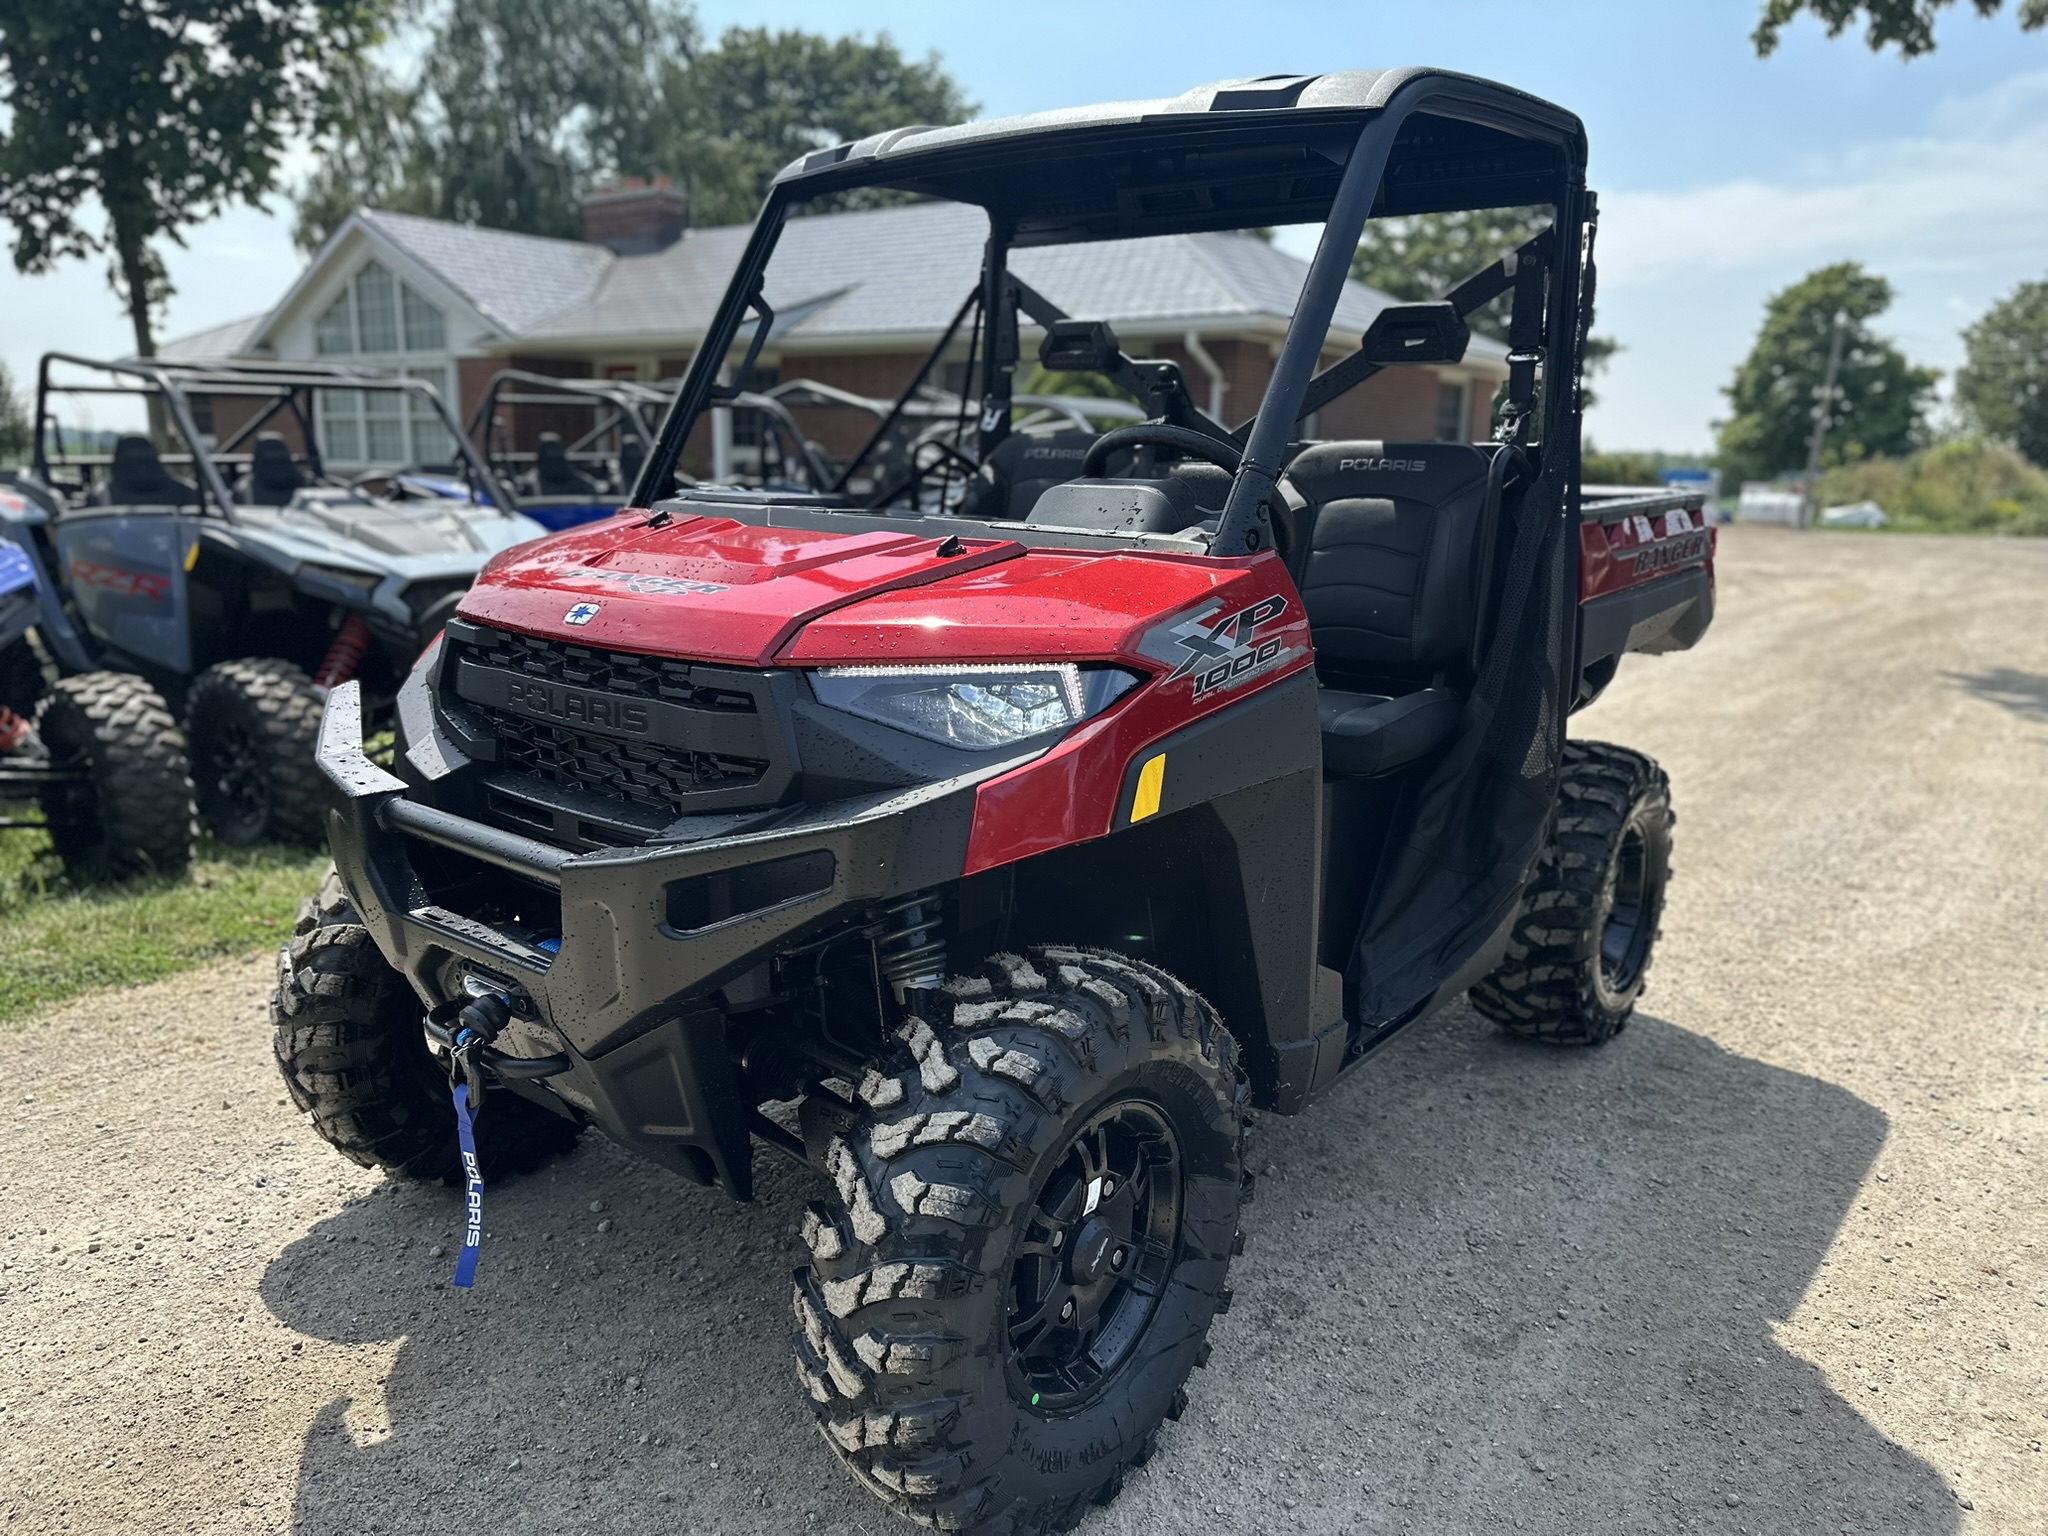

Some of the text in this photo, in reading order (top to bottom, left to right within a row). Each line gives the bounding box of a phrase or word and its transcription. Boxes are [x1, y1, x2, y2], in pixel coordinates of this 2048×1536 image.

[1024, 447, 1086, 460] POLARIS
[1340, 458, 1427, 472] POLARIS
[1632, 534, 1704, 577] RANGER
[71, 560, 172, 603] RZR
[1160, 593, 1288, 687] XP
[1191, 636, 1282, 699] 1000
[1193, 657, 1279, 706] DUAL OVERHEAD CAM
[508, 679, 649, 736] POLARIS
[463, 1151, 482, 1247] POLARIS
